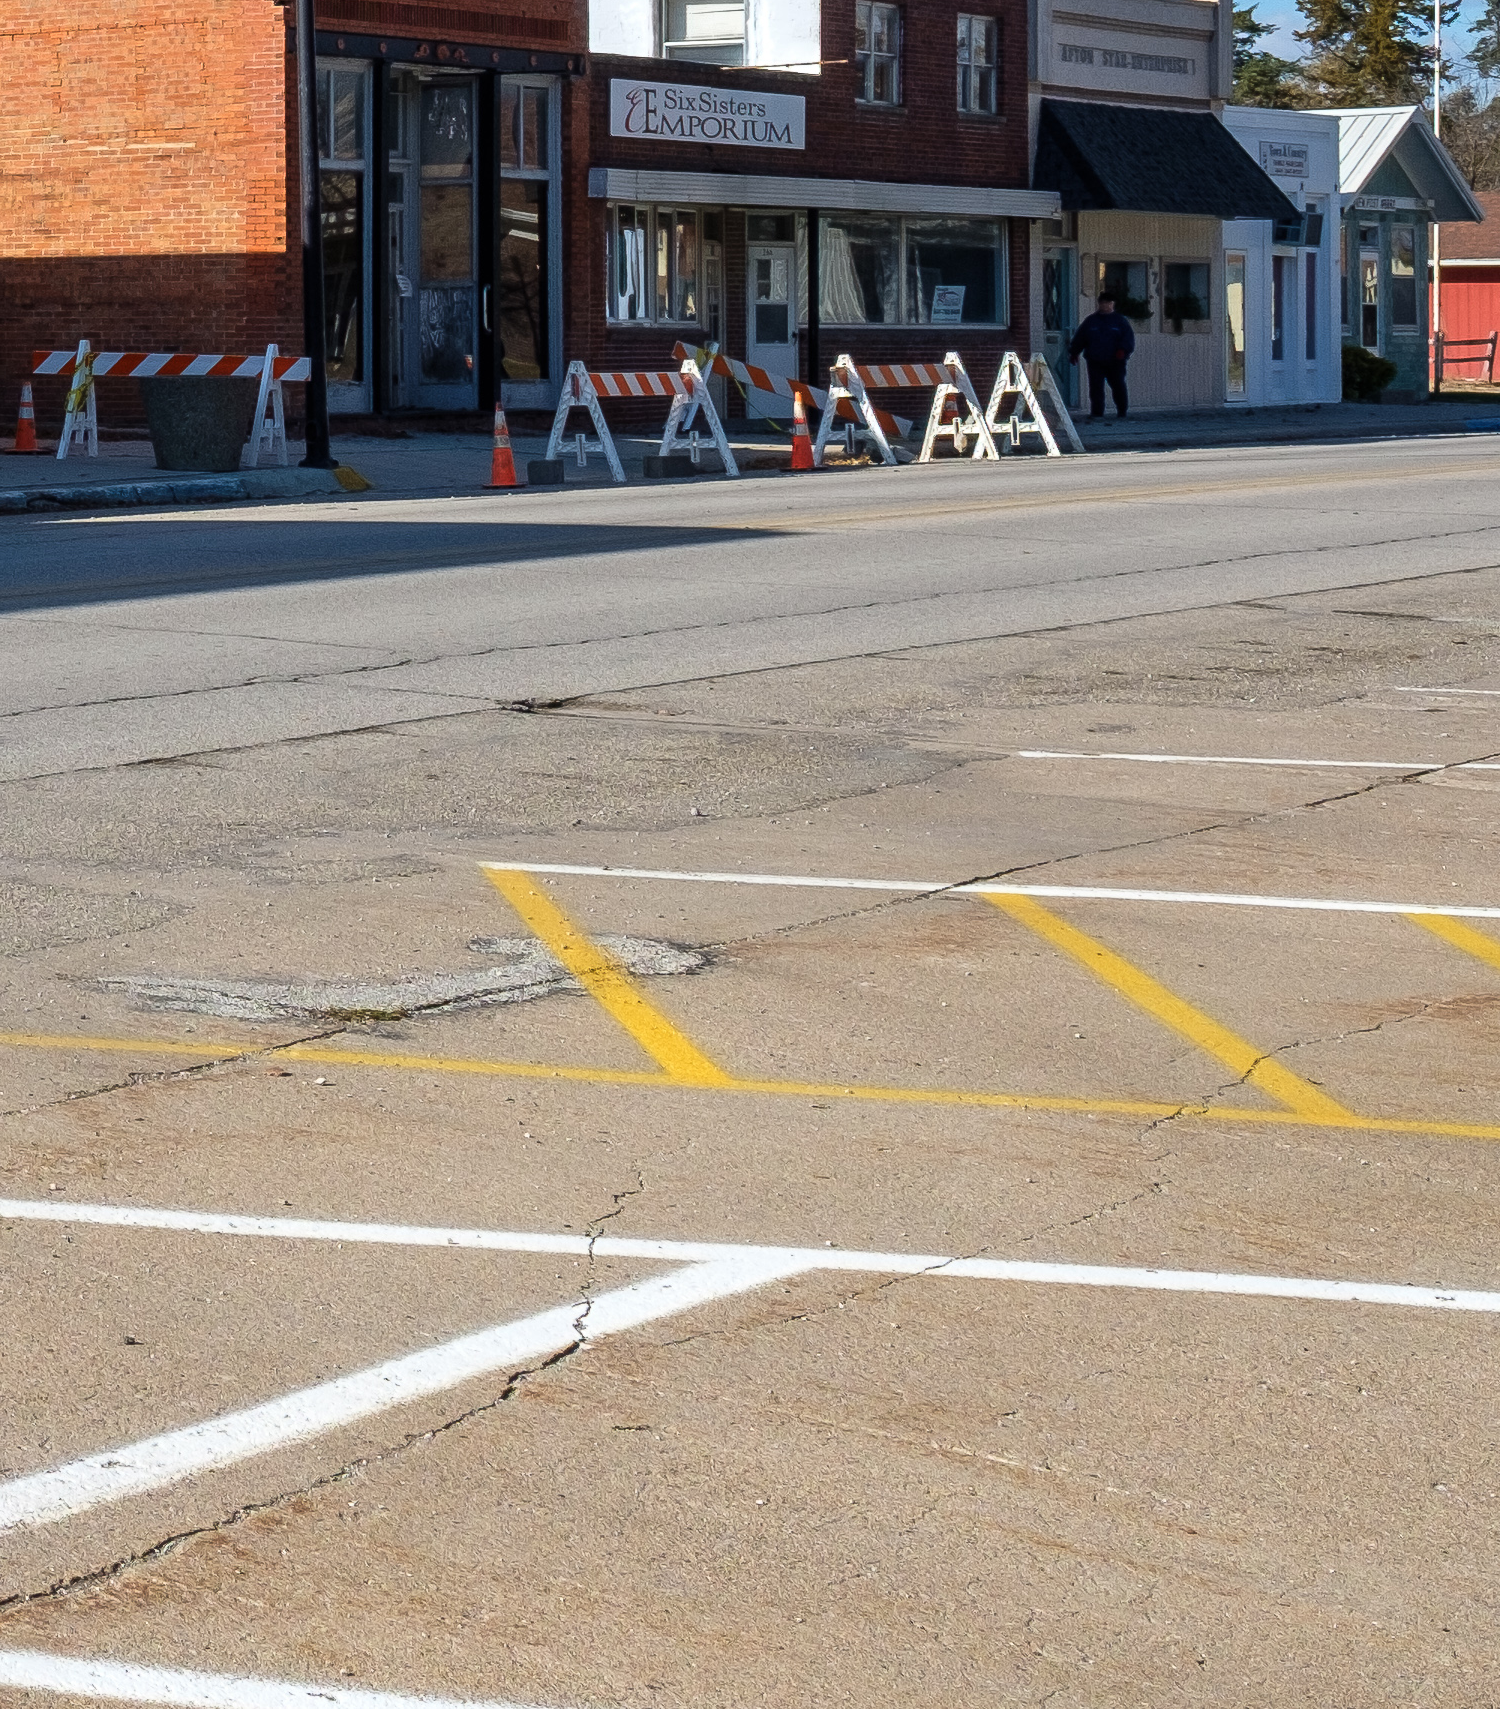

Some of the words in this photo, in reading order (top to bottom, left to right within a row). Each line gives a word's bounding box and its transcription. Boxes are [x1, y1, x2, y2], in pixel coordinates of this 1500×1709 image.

[642, 88, 794, 144] EMPORIUM
[664, 88, 696, 111] Six
[699, 92, 766, 117] Sisters
